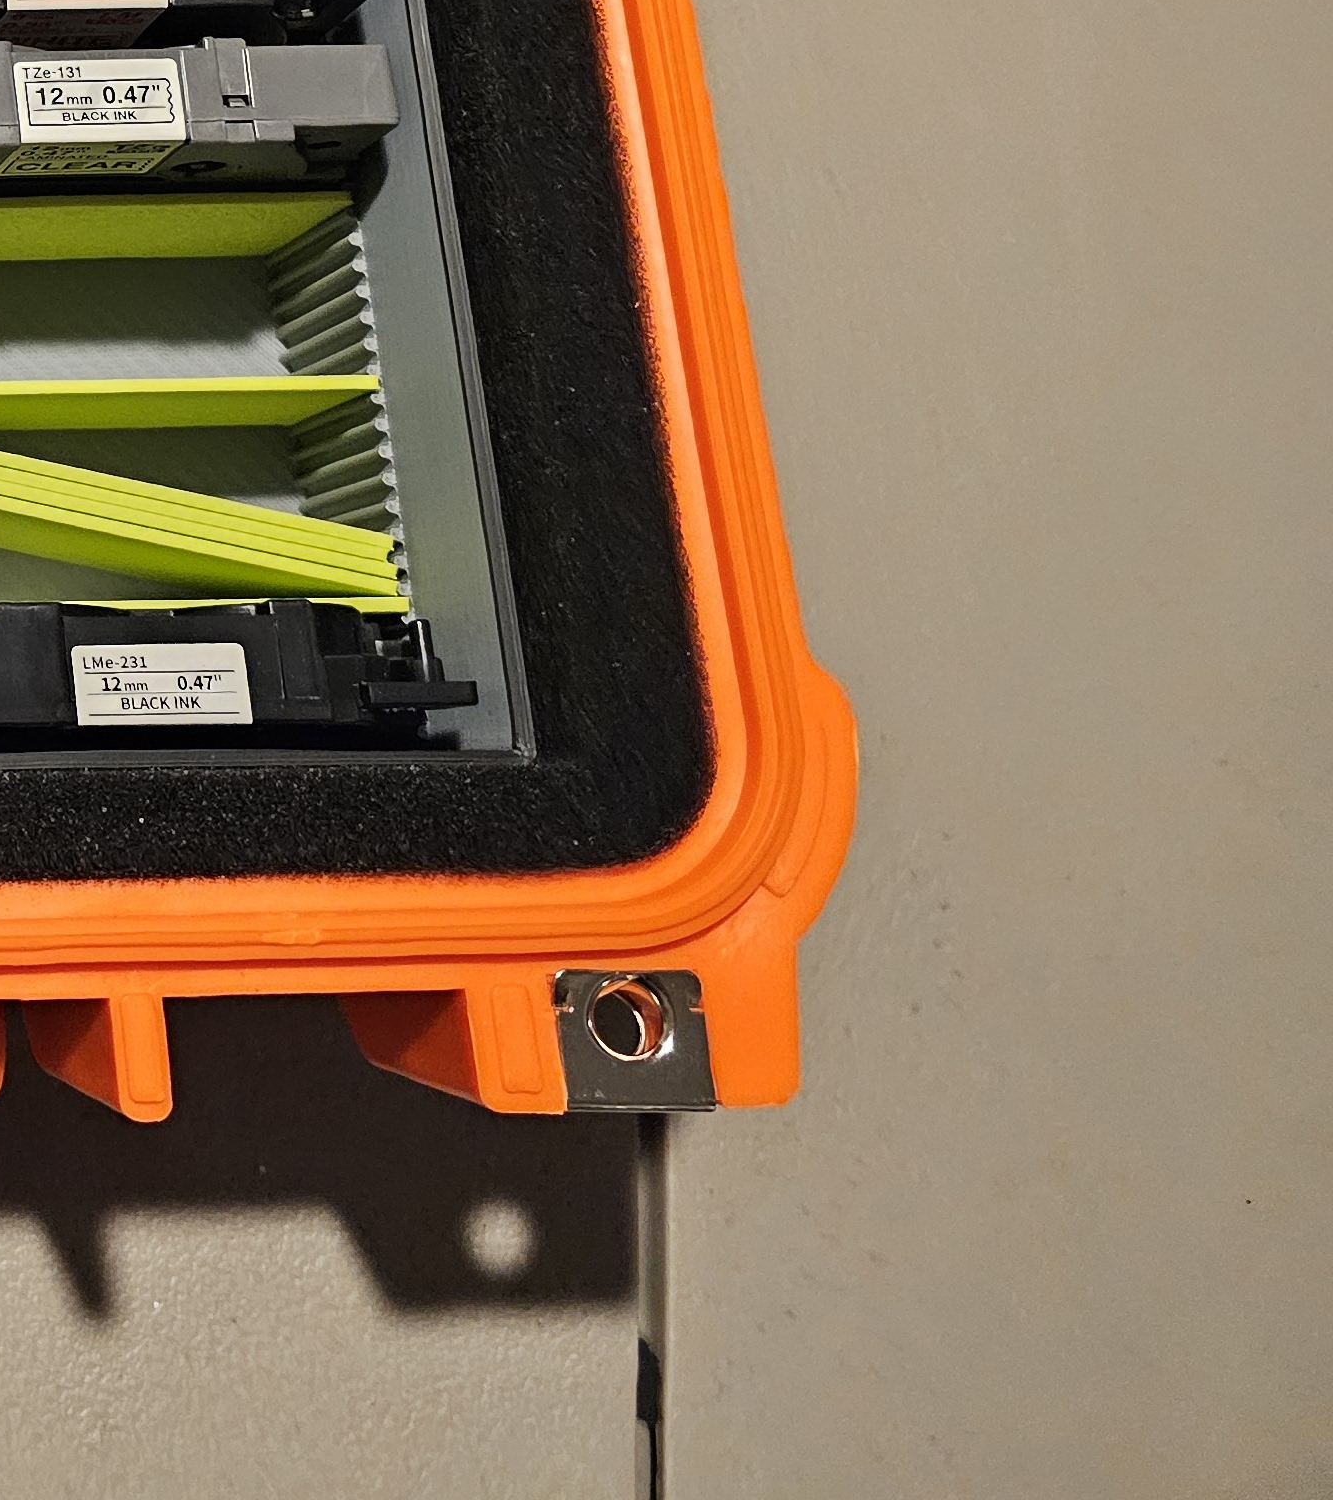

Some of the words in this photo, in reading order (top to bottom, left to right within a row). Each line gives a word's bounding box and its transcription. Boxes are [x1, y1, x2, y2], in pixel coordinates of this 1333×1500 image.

[22, 67, 81, 79] TZe-131
[62, 112, 108, 121] BLACK
[114, 110, 137, 120] INK
[16, 161, 137, 170] CLEAR
[83, 656, 147, 669] LMe-231
[121, 697, 170, 710] BLACK
[174, 696, 201, 709] INK
